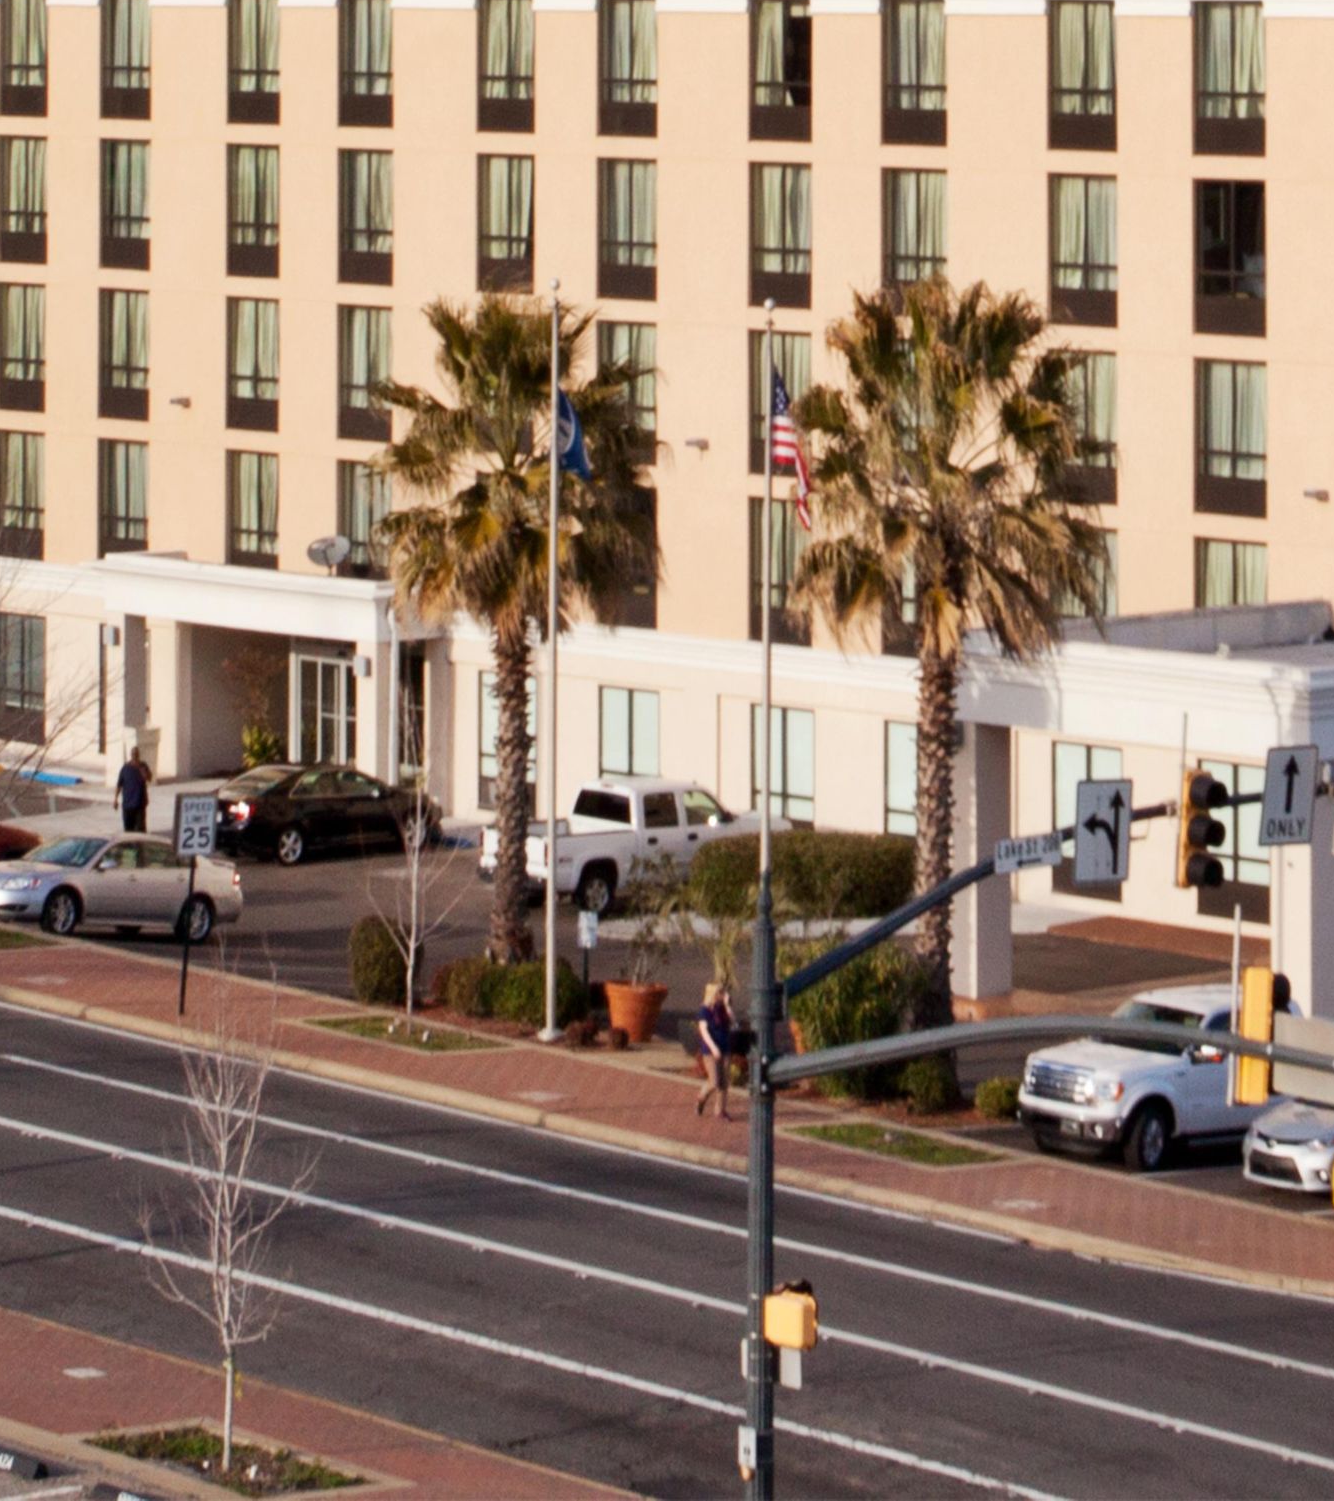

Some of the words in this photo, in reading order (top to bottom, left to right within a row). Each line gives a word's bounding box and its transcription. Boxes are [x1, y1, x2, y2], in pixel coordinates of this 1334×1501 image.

[184, 802, 212, 813] SPEED
[182, 826, 210, 849] 25
[1267, 817, 1306, 839] ONLY
[997, 841, 1023, 860] Lake
[1026, 838, 1037, 856] St
